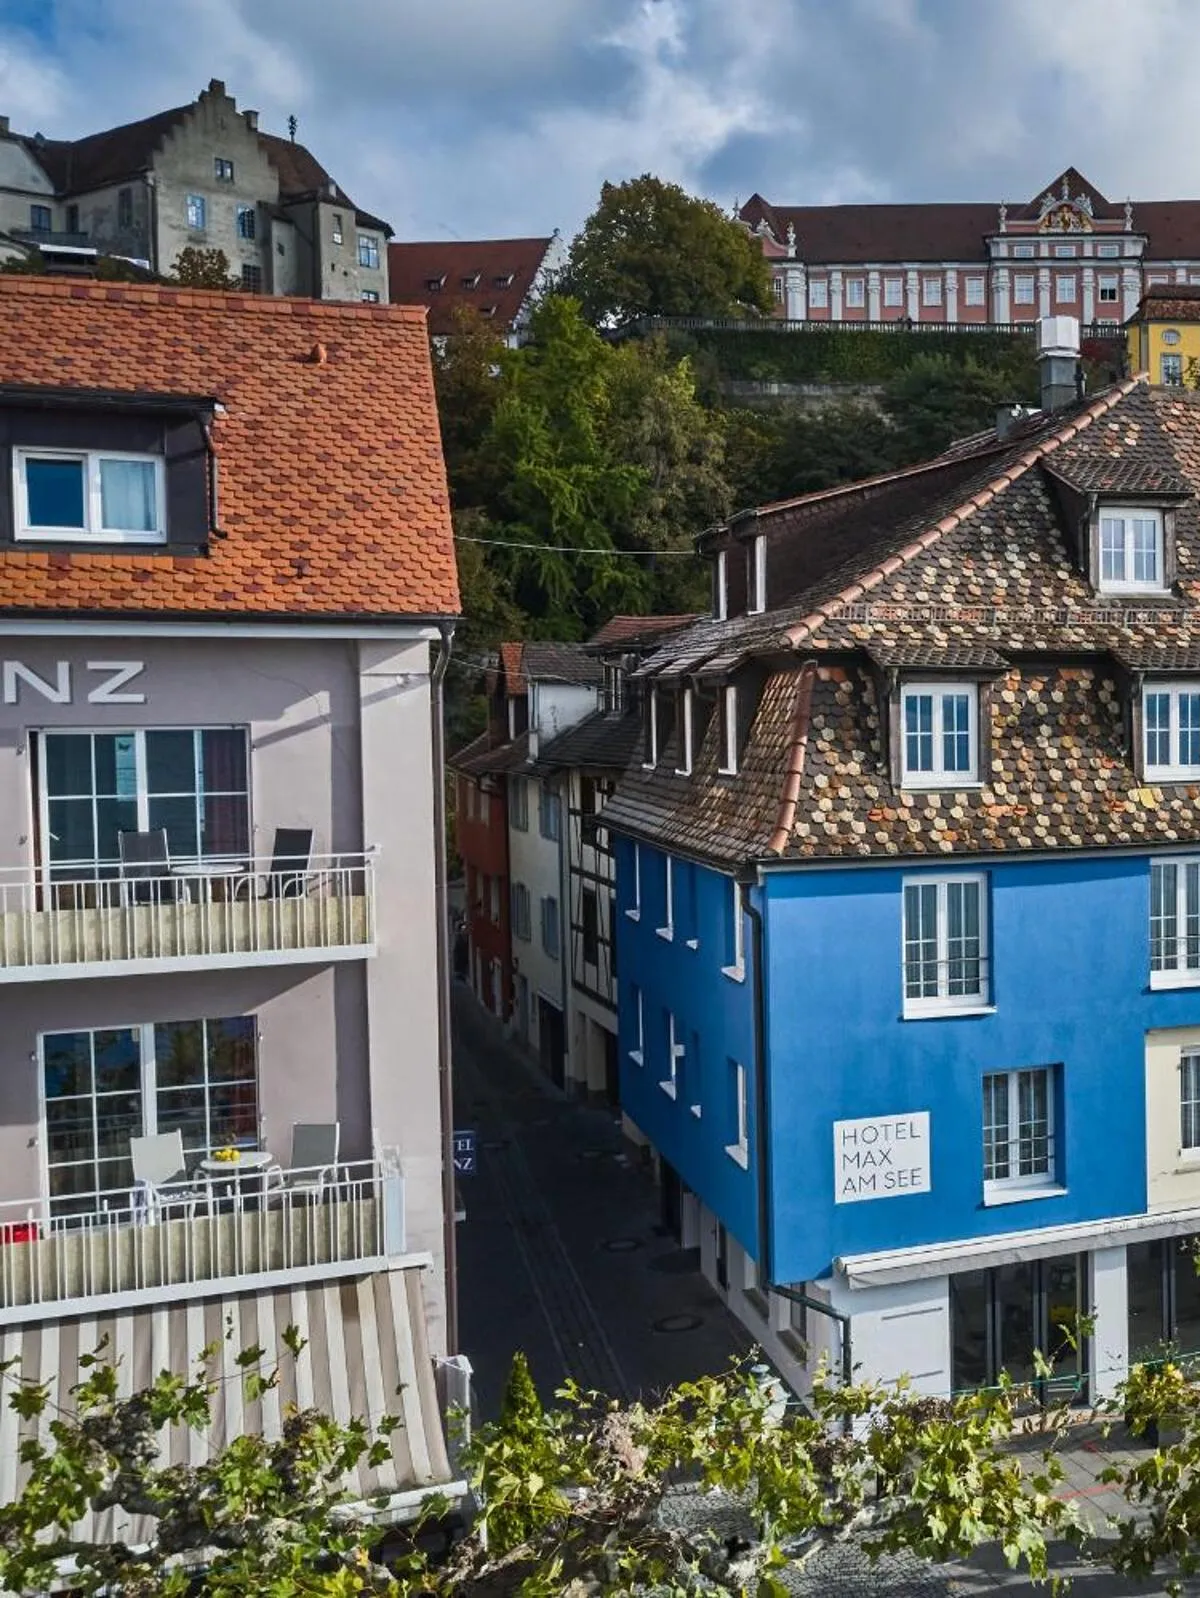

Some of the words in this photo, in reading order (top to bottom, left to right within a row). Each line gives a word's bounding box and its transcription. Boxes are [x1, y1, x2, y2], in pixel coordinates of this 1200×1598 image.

[3, 660, 146, 704] NZ
[453, 1139, 474, 1151] EL
[842, 1121, 921, 1147] HOTEL
[842, 1147, 893, 1170] MAX
[842, 1173, 876, 1194] AM
[884, 1167, 922, 1189] SEE
